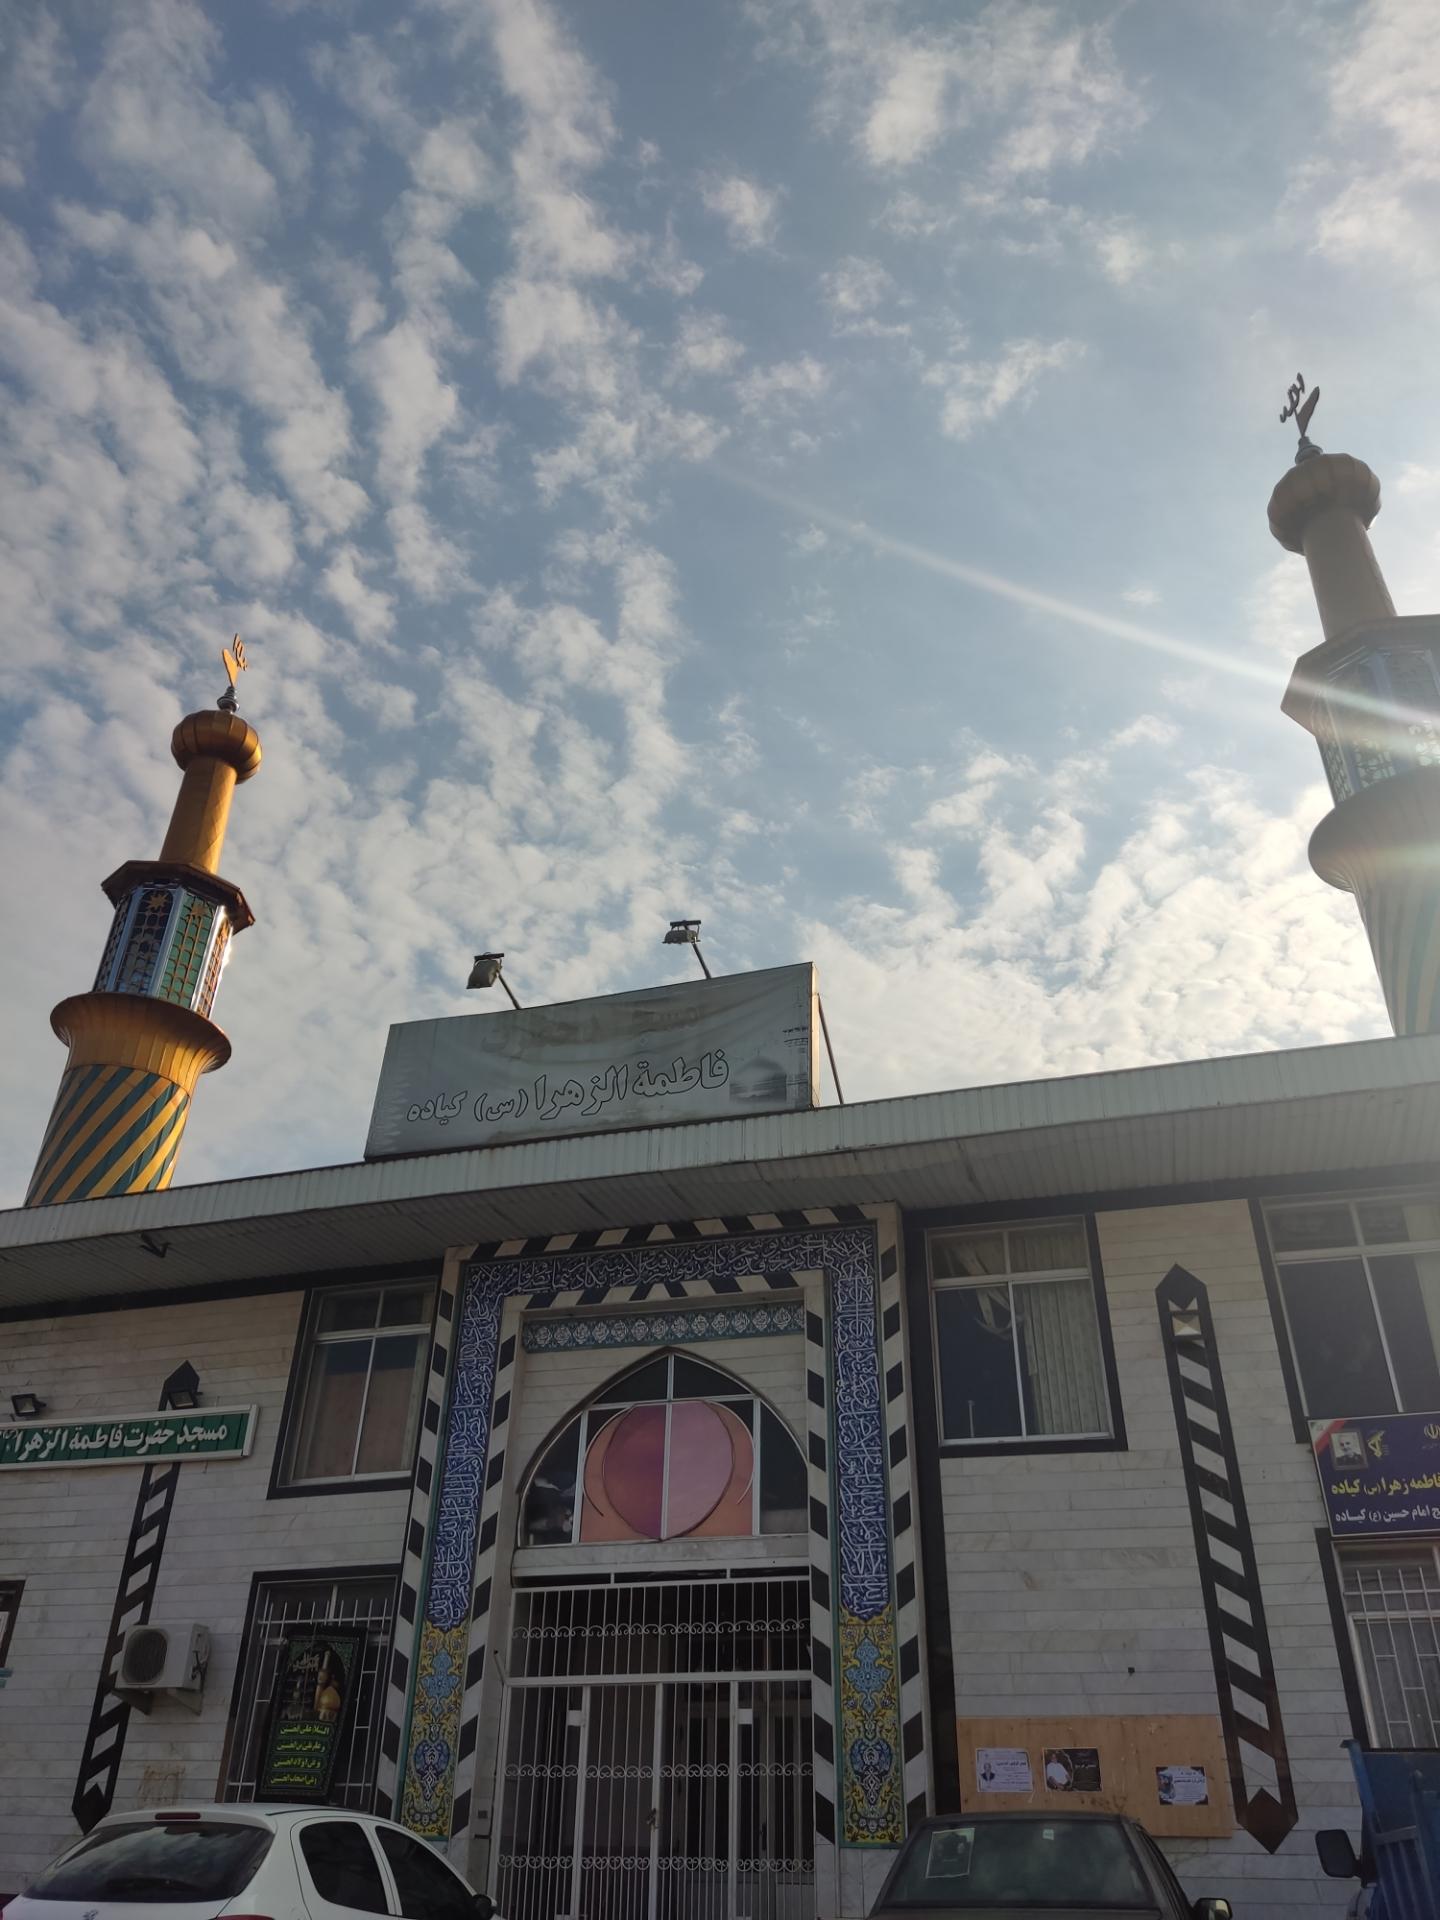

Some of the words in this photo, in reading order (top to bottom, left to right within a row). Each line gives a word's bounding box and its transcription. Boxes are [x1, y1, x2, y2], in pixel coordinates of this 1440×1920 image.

[632, 1049, 729, 1097] فاطمة
[534, 1064, 629, 1121] الزهرا
[124, 1421, 175, 1454] حضرت
[176, 1424, 228, 1450] مسجد
[1383, 1509, 1410, 1523] حسین
